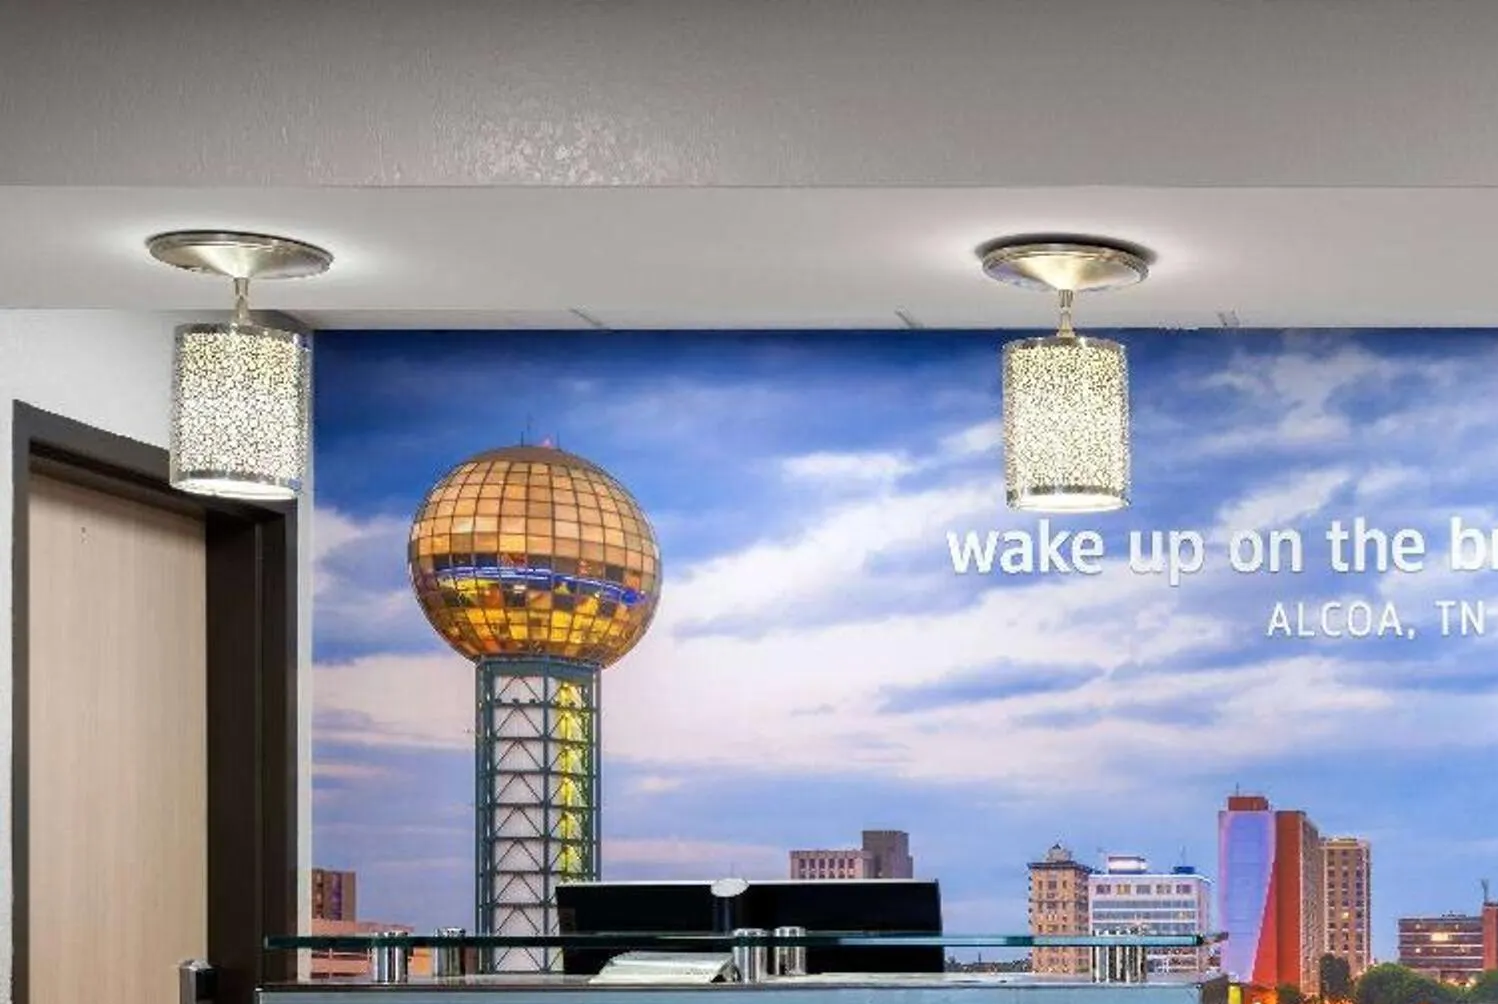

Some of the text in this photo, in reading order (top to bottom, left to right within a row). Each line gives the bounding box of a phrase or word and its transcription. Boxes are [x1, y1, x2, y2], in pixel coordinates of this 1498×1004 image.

[946, 519, 1104, 574] wake
[1129, 529, 1204, 587] up
[1229, 529, 1303, 573] on
[1326, 517, 1426, 573] the
[1267, 600, 1486, 640] ALCOA, TN
